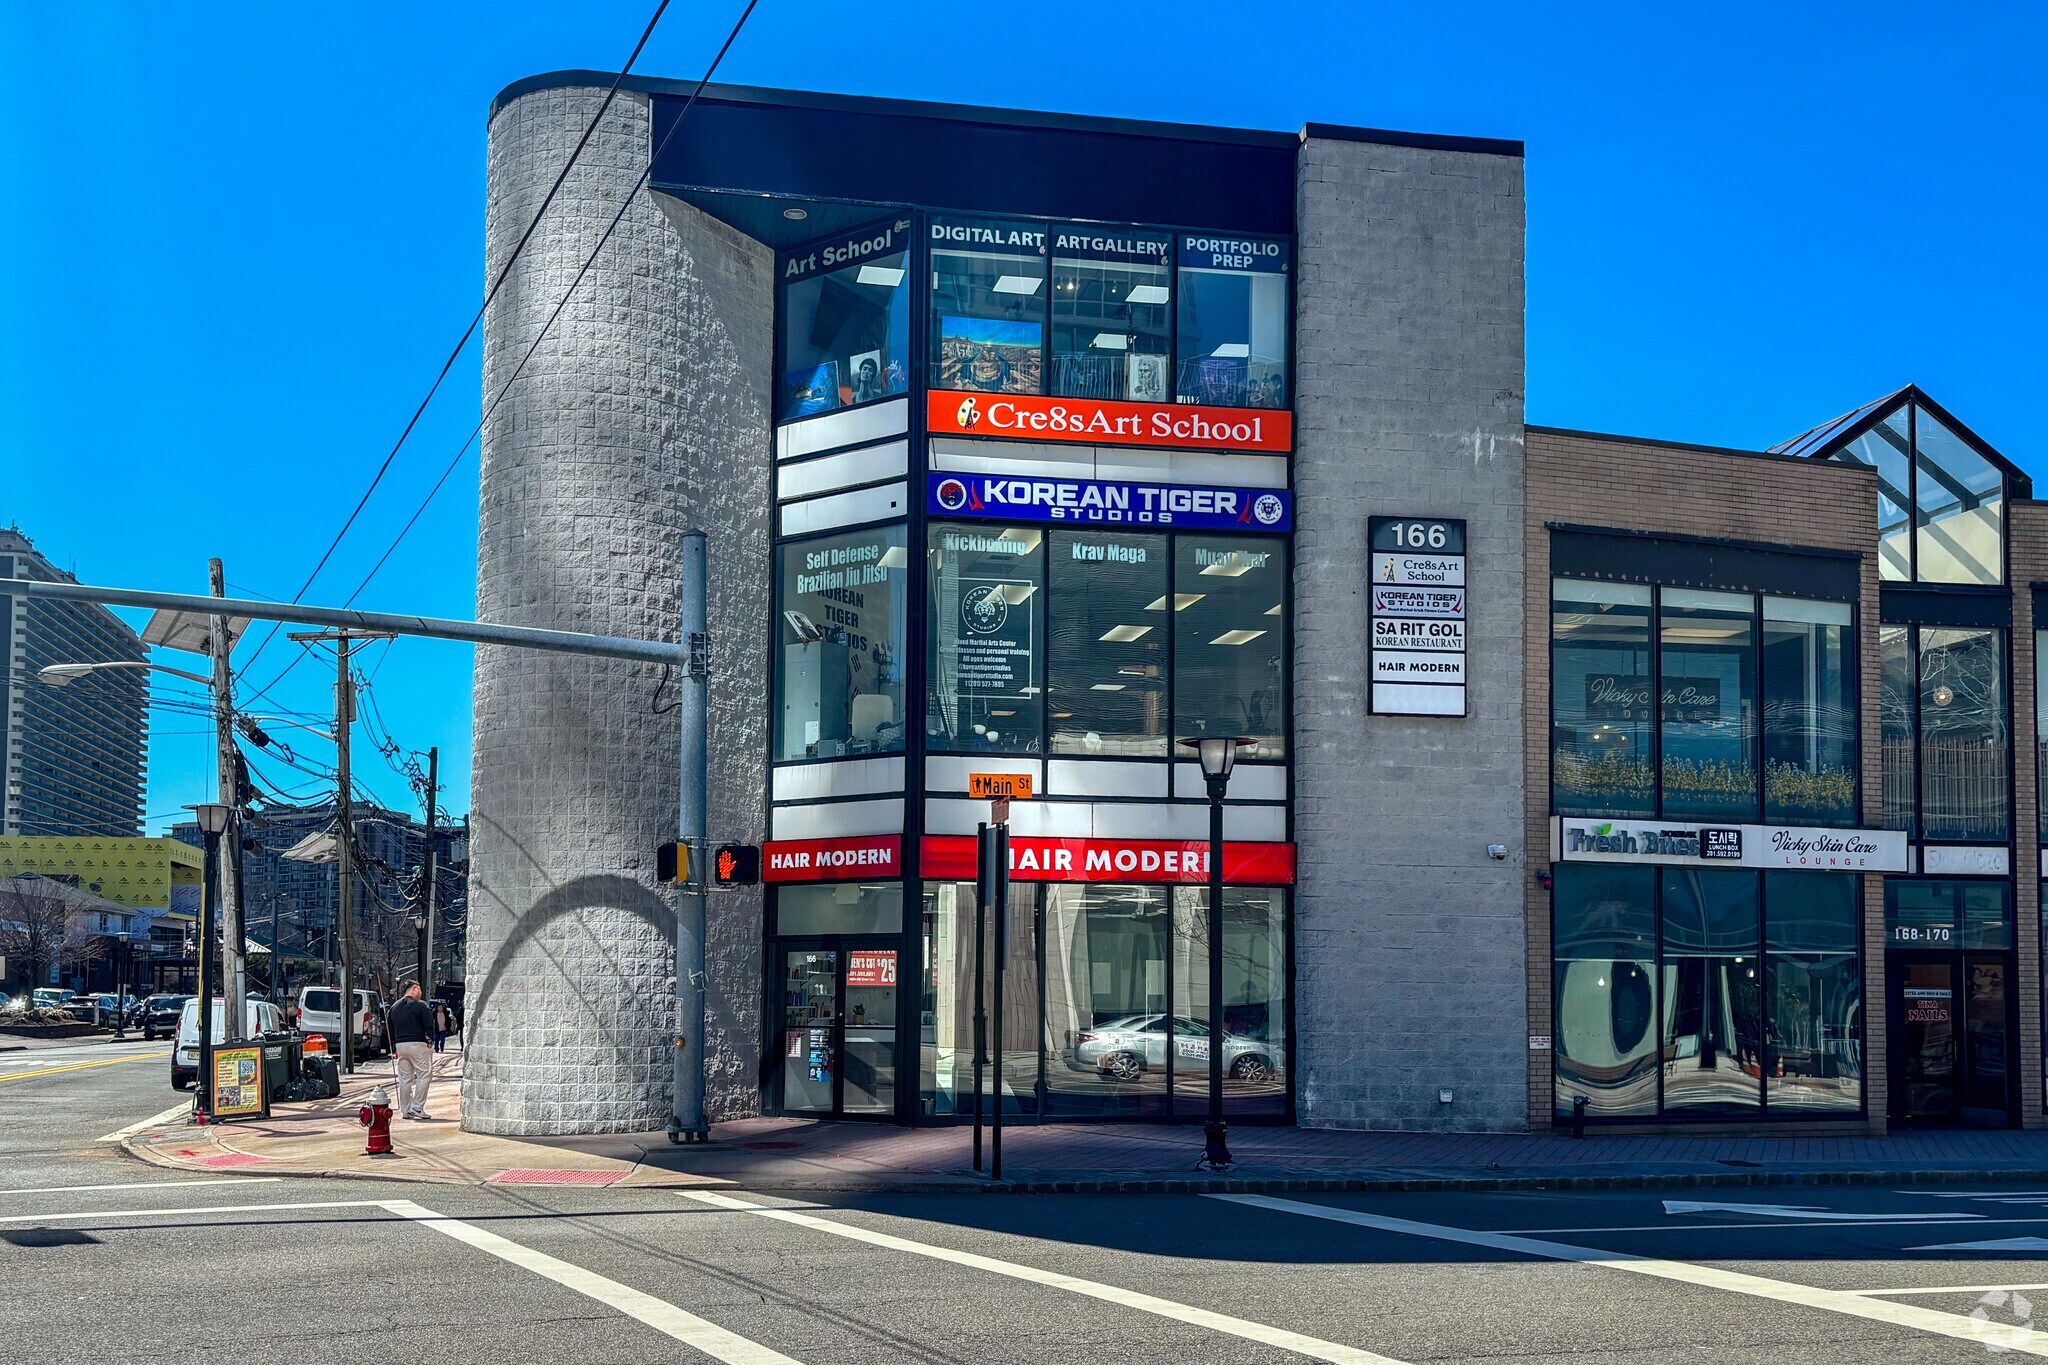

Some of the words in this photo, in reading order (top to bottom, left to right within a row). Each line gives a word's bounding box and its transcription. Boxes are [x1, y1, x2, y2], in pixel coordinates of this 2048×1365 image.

[931, 225, 1005, 244] DIGITAL
[1008, 231, 1044, 246] ART
[786, 252, 816, 277] Art
[823, 229, 891, 266] School
[1186, 238, 1279, 257] PORTFOLIO
[1212, 254, 1253, 268] PREP
[988, 403, 1142, 435] Cre8sArt
[1151, 412, 1262, 442] School
[984, 480, 1129, 510] KOREAN
[1137, 488, 1237, 514] TIGER
[1051, 507, 1173, 523] STUDIOS
[1392, 523, 1446, 548] 166
[806, 550, 829, 570] Self
[831, 544, 879, 567] Defense
[1072, 542, 1104, 560] Krav
[1107, 544, 1146, 564] Maga
[797, 570, 843, 594] Brazilian
[845, 567, 860, 587] Jiu
[862, 564, 888, 585] Jitsu
[1408, 571, 1445, 581] School
[1381, 592, 1424, 600] KOREAN
[824, 604, 859, 628] TIGER
[815, 624, 867, 652] STIOS
[1376, 622, 1396, 635] SA
[1401, 623, 1425, 635] RIT
[1429, 624, 1462, 637] GOL
[1376, 636, 1409, 646] KOREAN
[1411, 638, 1462, 648] RESTAURANT
[1379, 662, 1405, 671] HAIR
[1410, 663, 1460, 672] MODERN
[1591, 678, 1637, 707] Vicky
[1679, 687, 1717, 705] Care
[984, 777, 1012, 794] Main
[1019, 778, 1030, 789] St
[1568, 828, 1638, 854] Fresh
[1640, 831, 1700, 856] Bites
[1709, 831, 1737, 844] 도시락
[1772, 831, 1810, 855] Vicky
[1811, 835, 1844, 853] Skin
[1845, 836, 1878, 854] Care
[771, 852, 810, 869] HAIR
[815, 848, 891, 867] MODERN
[1085, 849, 1210, 873] MODER
[1785, 856, 1865, 866] LOUNGE
[1895, 928, 1949, 940] 168-170
[806, 955, 816, 963] 166
[1917, 1000, 1938, 1008] TINA
[1908, 1009, 1948, 1021] NAILS
